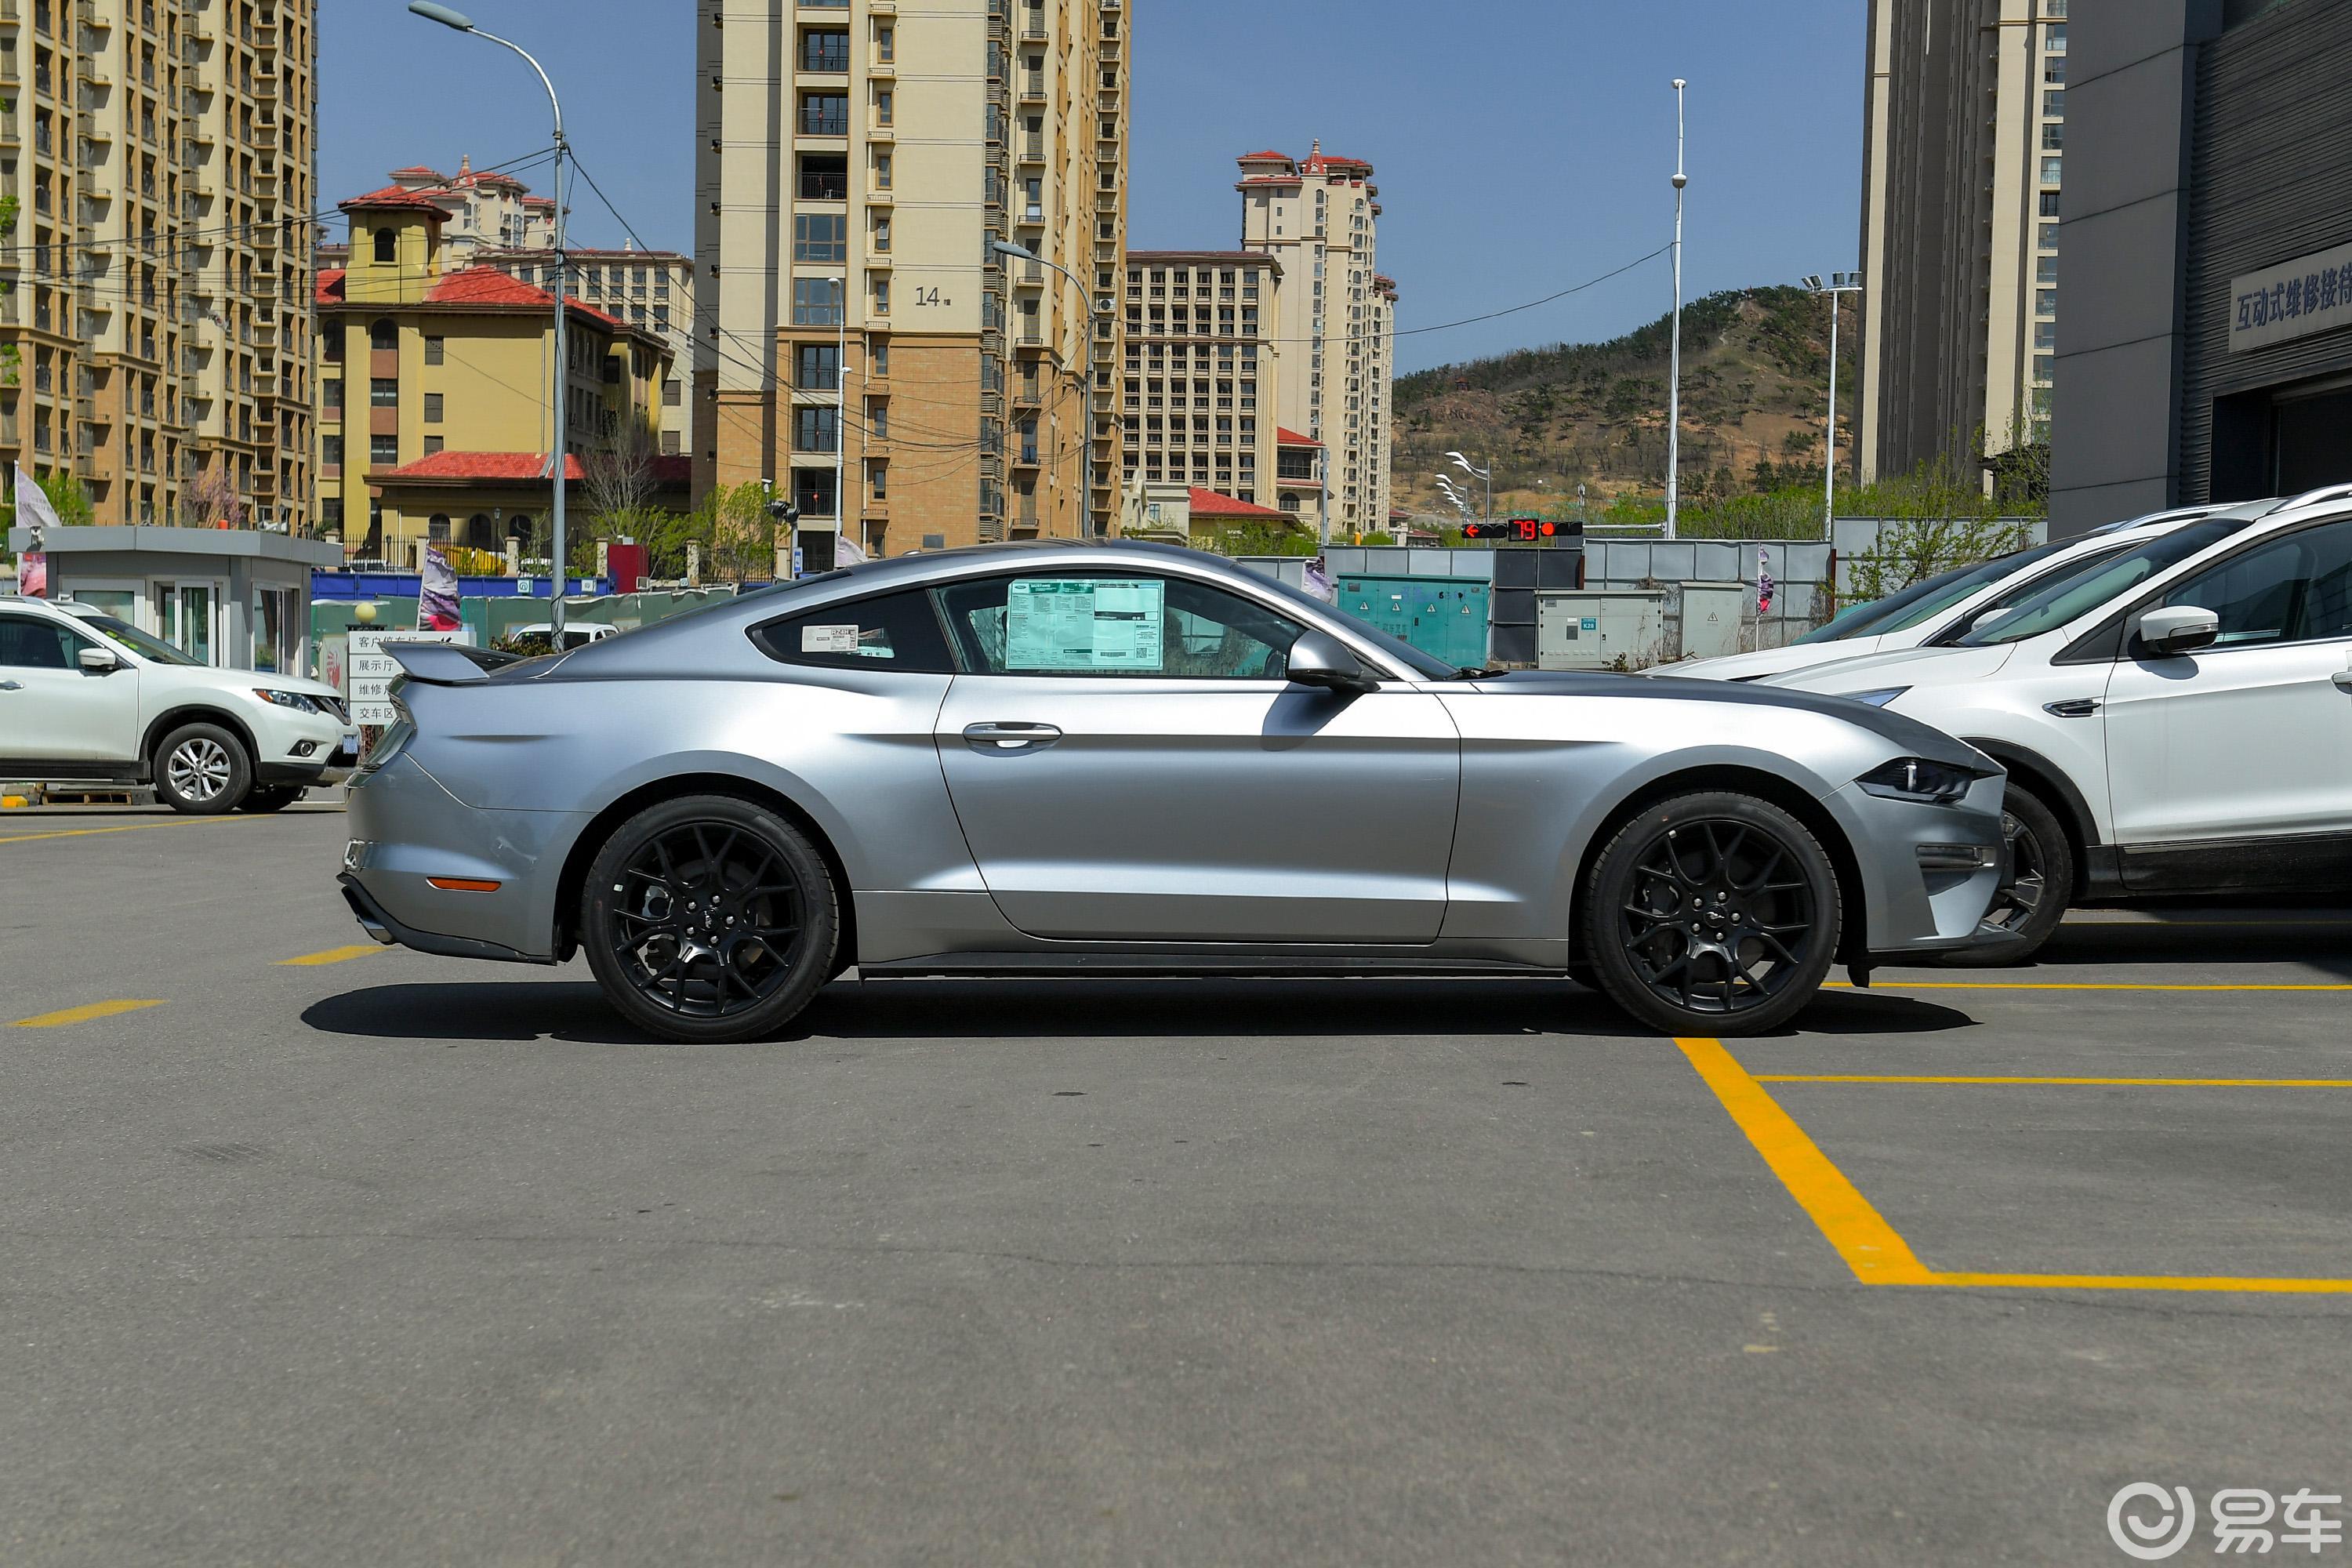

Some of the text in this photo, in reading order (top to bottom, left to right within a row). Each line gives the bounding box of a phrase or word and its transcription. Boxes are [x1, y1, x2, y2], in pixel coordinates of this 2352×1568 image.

[916, 286, 940, 307] 14
[1513, 520, 1536, 540] 79
[358, 659, 394, 671] 展示厅
[359, 706, 394, 720] 交车区
